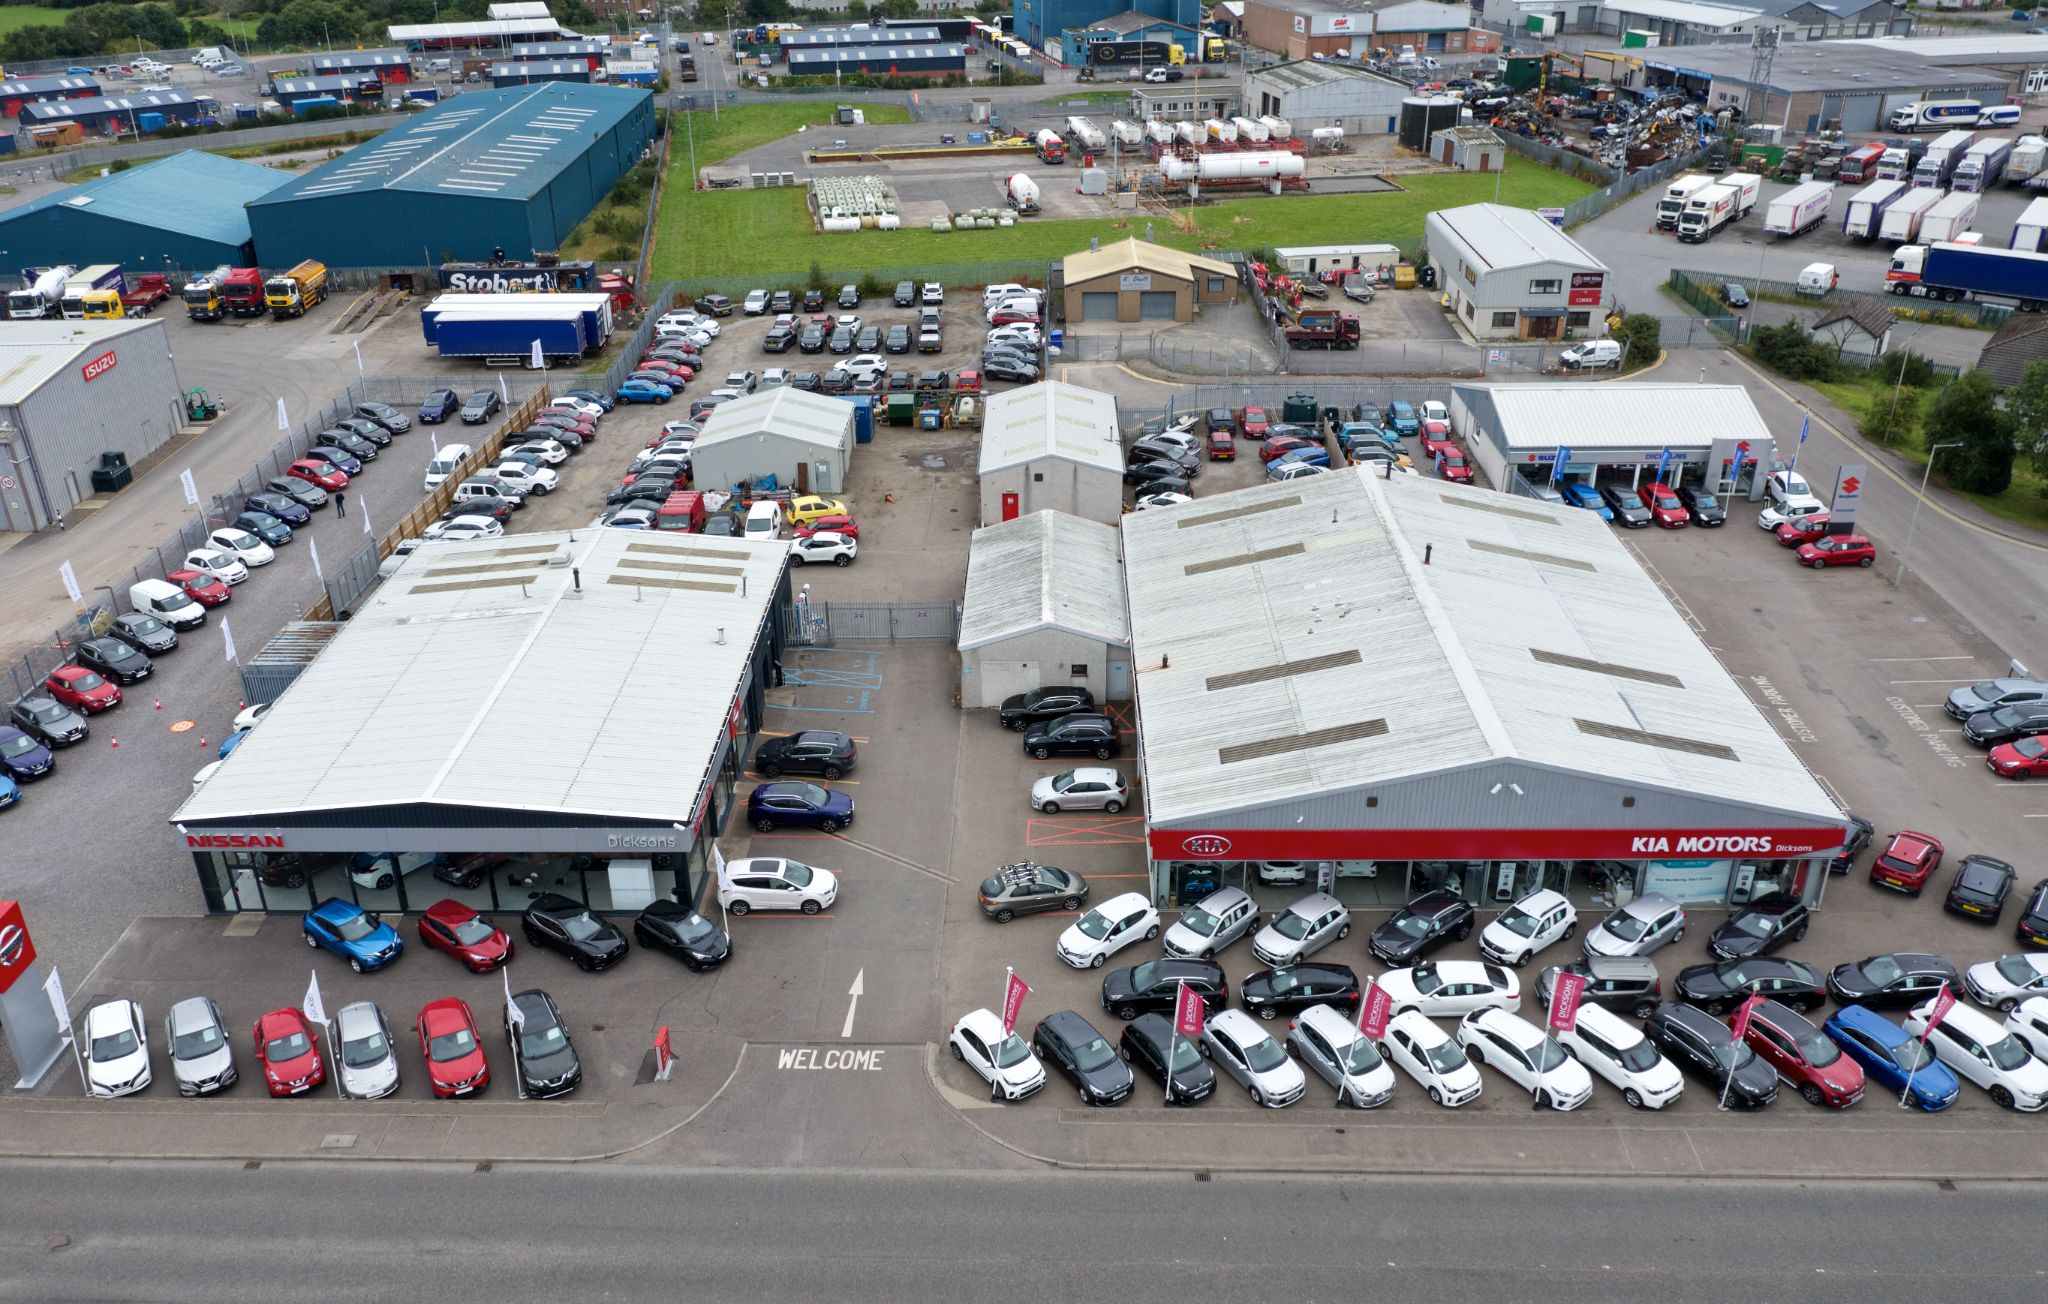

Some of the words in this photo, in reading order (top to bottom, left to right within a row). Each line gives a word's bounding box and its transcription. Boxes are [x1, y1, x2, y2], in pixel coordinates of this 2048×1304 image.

[85, 352, 115, 379] ISUZU
[1885, 696, 1930, 731] CUSTOMER
[1919, 734, 1967, 768] PARKING
[186, 835, 285, 848] NISSAN
[608, 834, 676, 848] Dicksons
[1631, 837, 1670, 853] KIA
[1675, 836, 1772, 853] MOTORS
[1775, 844, 1813, 852] Dicksons
[1368, 991, 1383, 1025] DICKSONS
[1558, 979, 1574, 1018] DICKSONS
[778, 1049, 885, 1071] WELCOME
